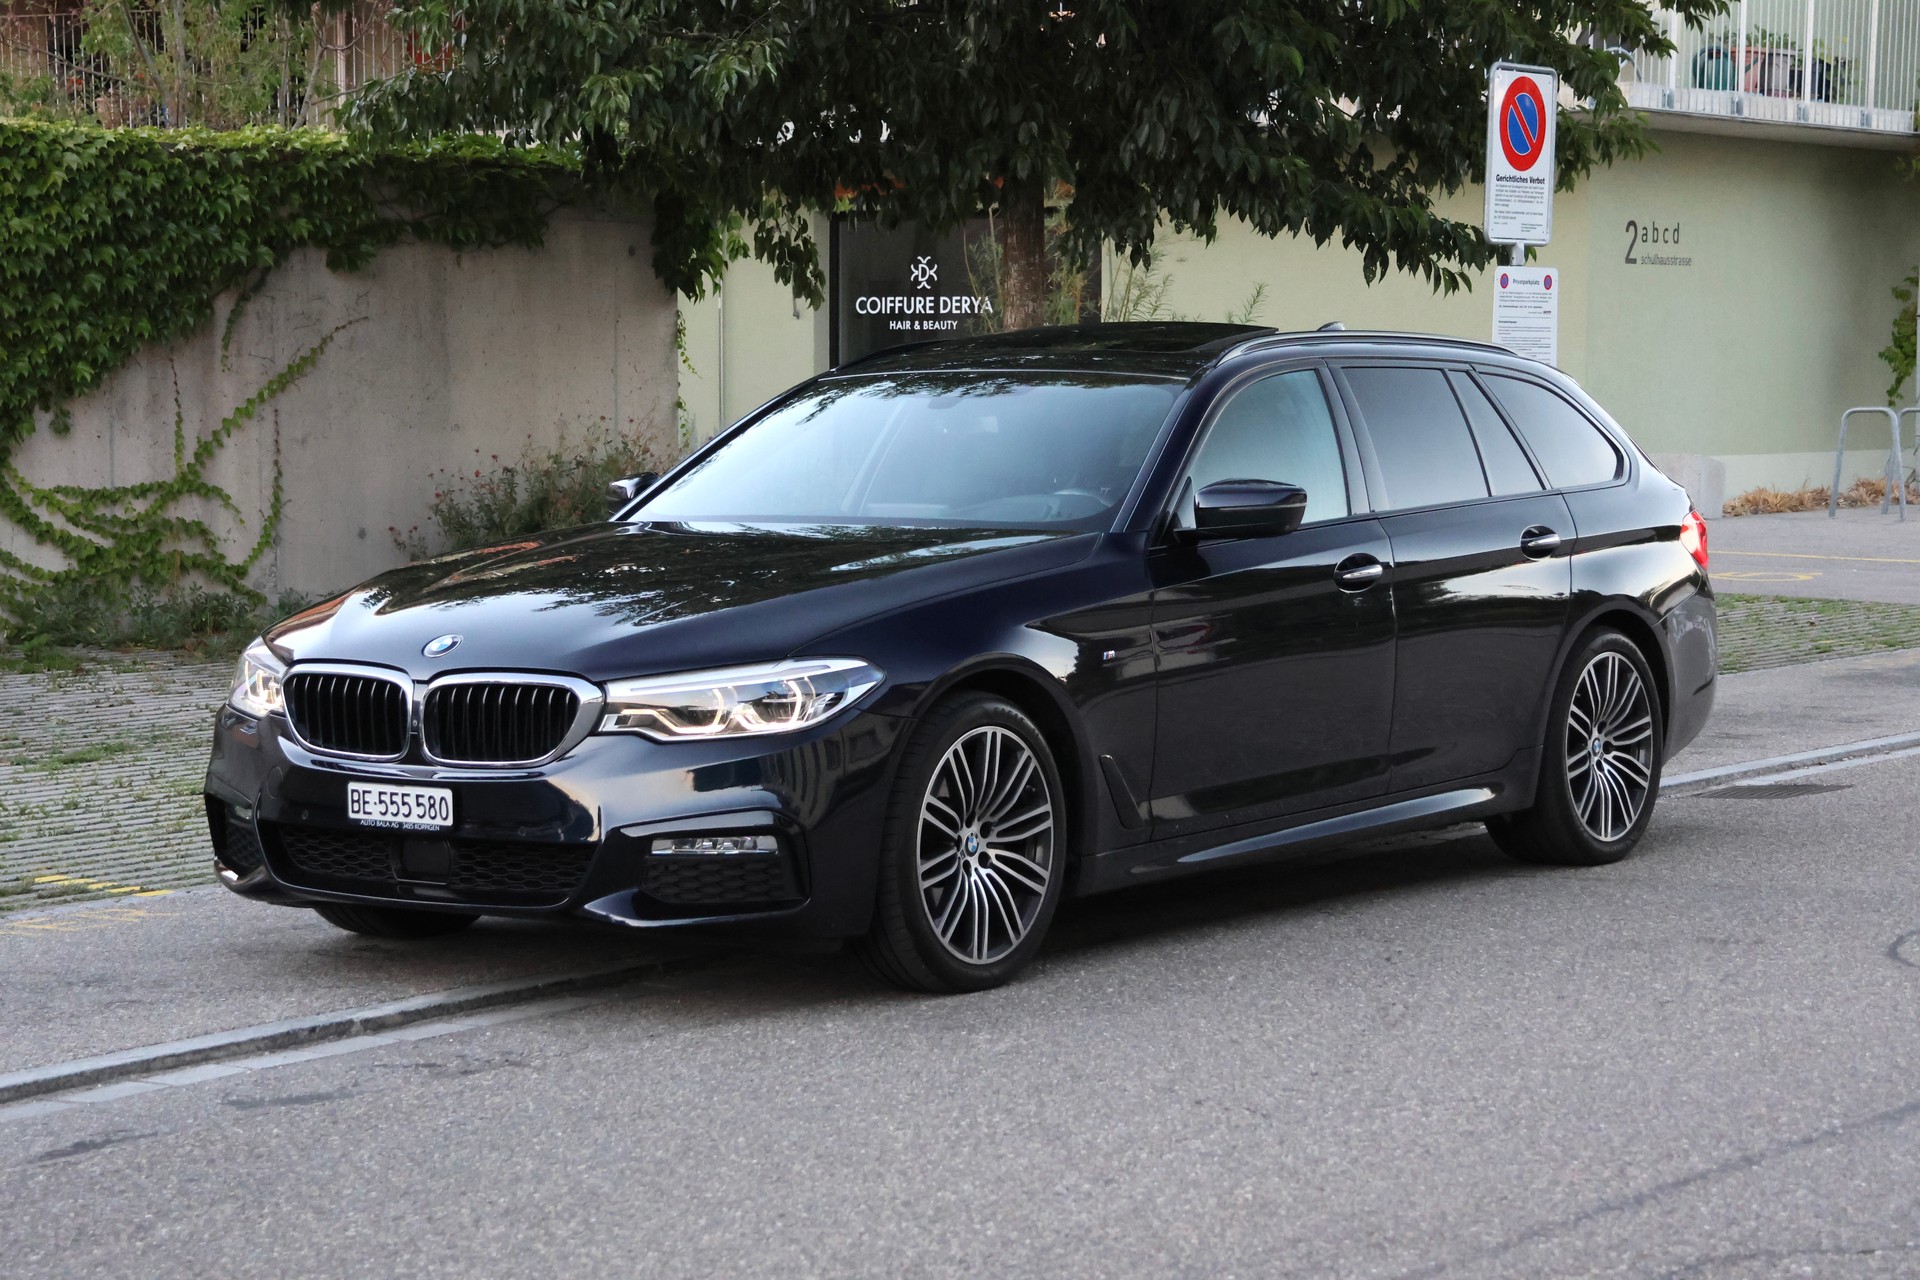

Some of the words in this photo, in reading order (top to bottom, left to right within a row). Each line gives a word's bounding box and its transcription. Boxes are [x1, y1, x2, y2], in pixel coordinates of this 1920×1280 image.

[1495, 174, 1529, 183] Gerichtliches
[1529, 176, 1546, 184] Verbot
[1625, 219, 1638, 264] 2
[1641, 253, 1692, 266] schulhausstrasse
[855, 296, 935, 314] COIFFURE
[939, 296, 994, 314] DERYA
[889, 320, 911, 330] HAIR
[913, 320, 921, 330] &
[922, 320, 959, 330] BEAUTY
[360, 819, 376, 827] AUTO
